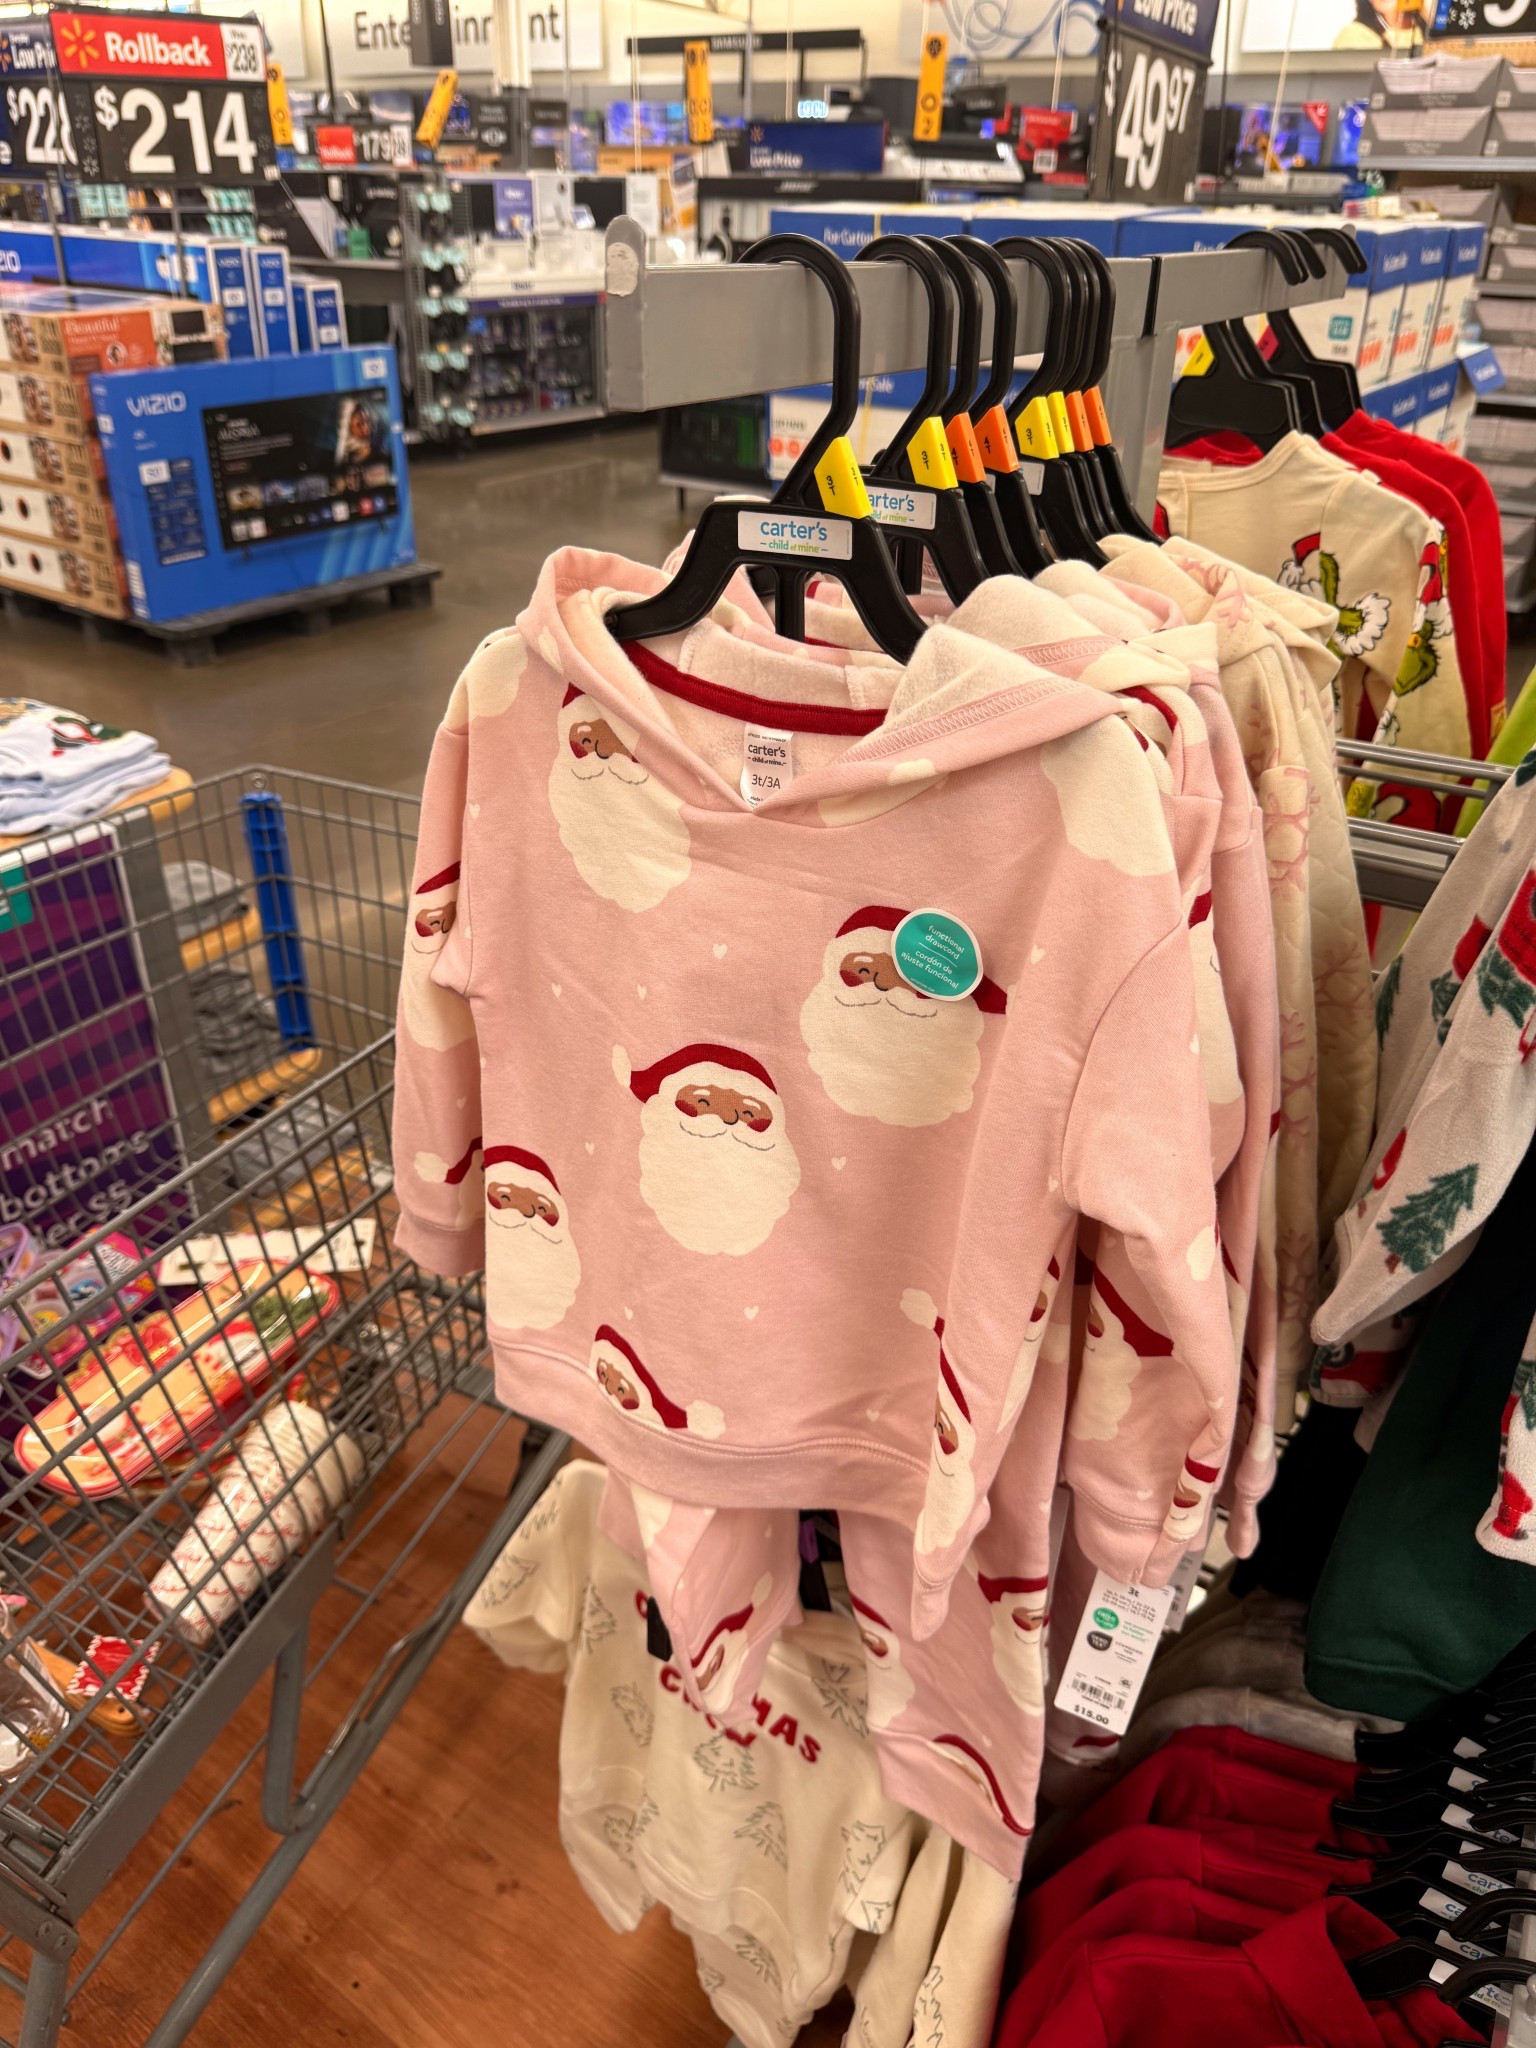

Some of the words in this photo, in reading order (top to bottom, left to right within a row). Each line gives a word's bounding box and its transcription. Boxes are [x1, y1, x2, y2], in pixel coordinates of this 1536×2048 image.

[11, 44, 36, 69] Low
[104, 31, 213, 67] Rollback
[94, 84, 258, 174] $214
[126, 390, 187, 417] VIZIO
[984, 436, 991, 455] 4T
[1025, 428, 1032, 446] 3T
[922, 450, 930, 470] 3T
[951, 448, 958, 466] 4T
[826, 475, 836, 496] 3T
[868, 493, 915, 512] arter's
[889, 512, 909, 523] mine
[760, 520, 828, 541] carter's
[768, 539, 789, 551] child
[797, 543, 819, 553] mine
[748, 744, 786, 758] carter's
[751, 773, 781, 790] 3t/3A
[925, 934, 960, 960] drawcord
[928, 925, 965, 954] functional
[901, 951, 924, 969] ajuste
[924, 964, 959, 989] funcional
[915, 950, 942, 968] cordón
[942, 965, 953, 975] de
[2, 1099, 114, 1172] match
[0, 1130, 150, 1222] bottoms
[1128, 1587, 1139, 1598] 3t
[1074, 1704, 1109, 1725] $15.00
